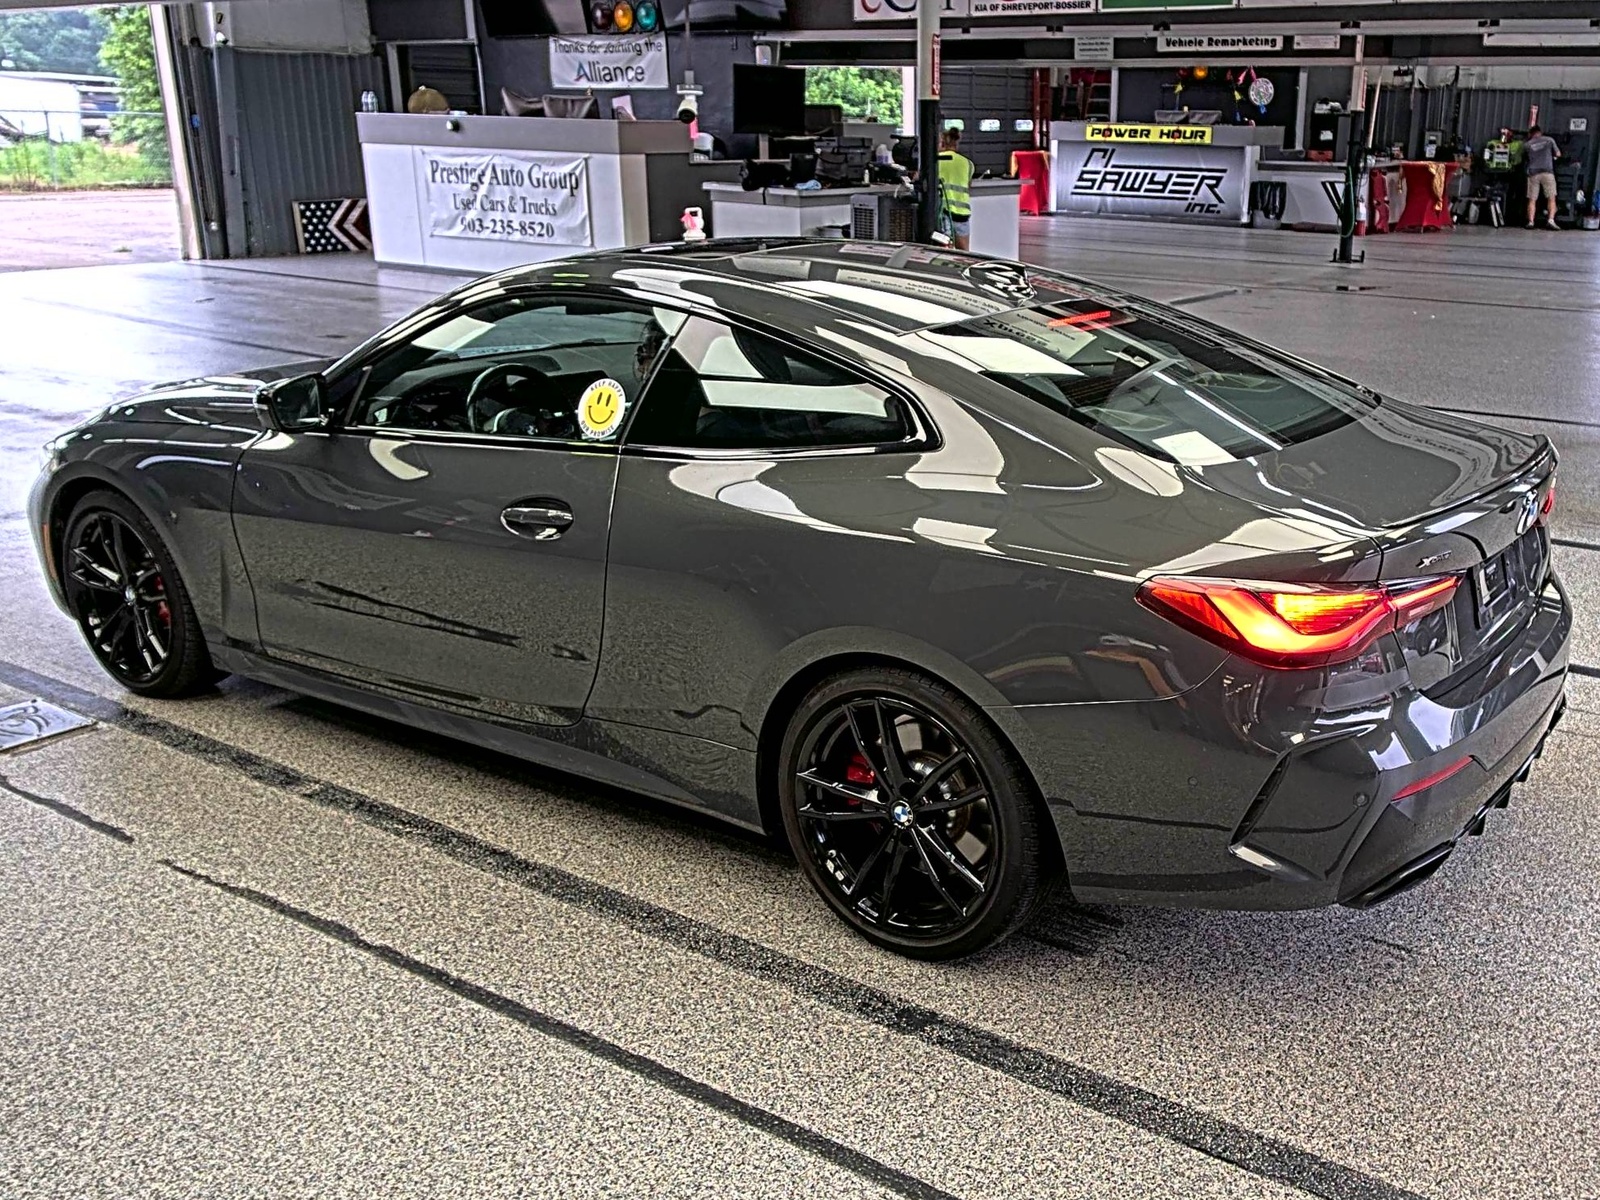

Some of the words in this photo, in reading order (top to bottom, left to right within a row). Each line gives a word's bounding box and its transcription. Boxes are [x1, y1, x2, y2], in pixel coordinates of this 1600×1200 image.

[974, 3, 988, 12] KIA
[989, 3, 1000, 12] OF
[1001, 1, 1091, 11] SHREVEPORT-BOSSIER
[553, 39, 585, 53] Thanks
[587, 41, 601, 53] for
[645, 36, 663, 52] the
[1165, 37, 1204, 47] Vehicle
[1207, 37, 1277, 48] Remarketing
[574, 60, 645, 82] Alliance
[1159, 128, 1206, 140] HOUR
[430, 159, 486, 192] Prestige
[489, 163, 525, 188] Auto
[528, 163, 580, 197] Group
[1073, 169, 1225, 203] SAWYER
[453, 193, 478, 211] Used
[480, 193, 506, 212] Cars
[507, 196, 517, 213] &
[519, 196, 557, 216] Trucks
[460, 216, 555, 238] 903-235-8520
